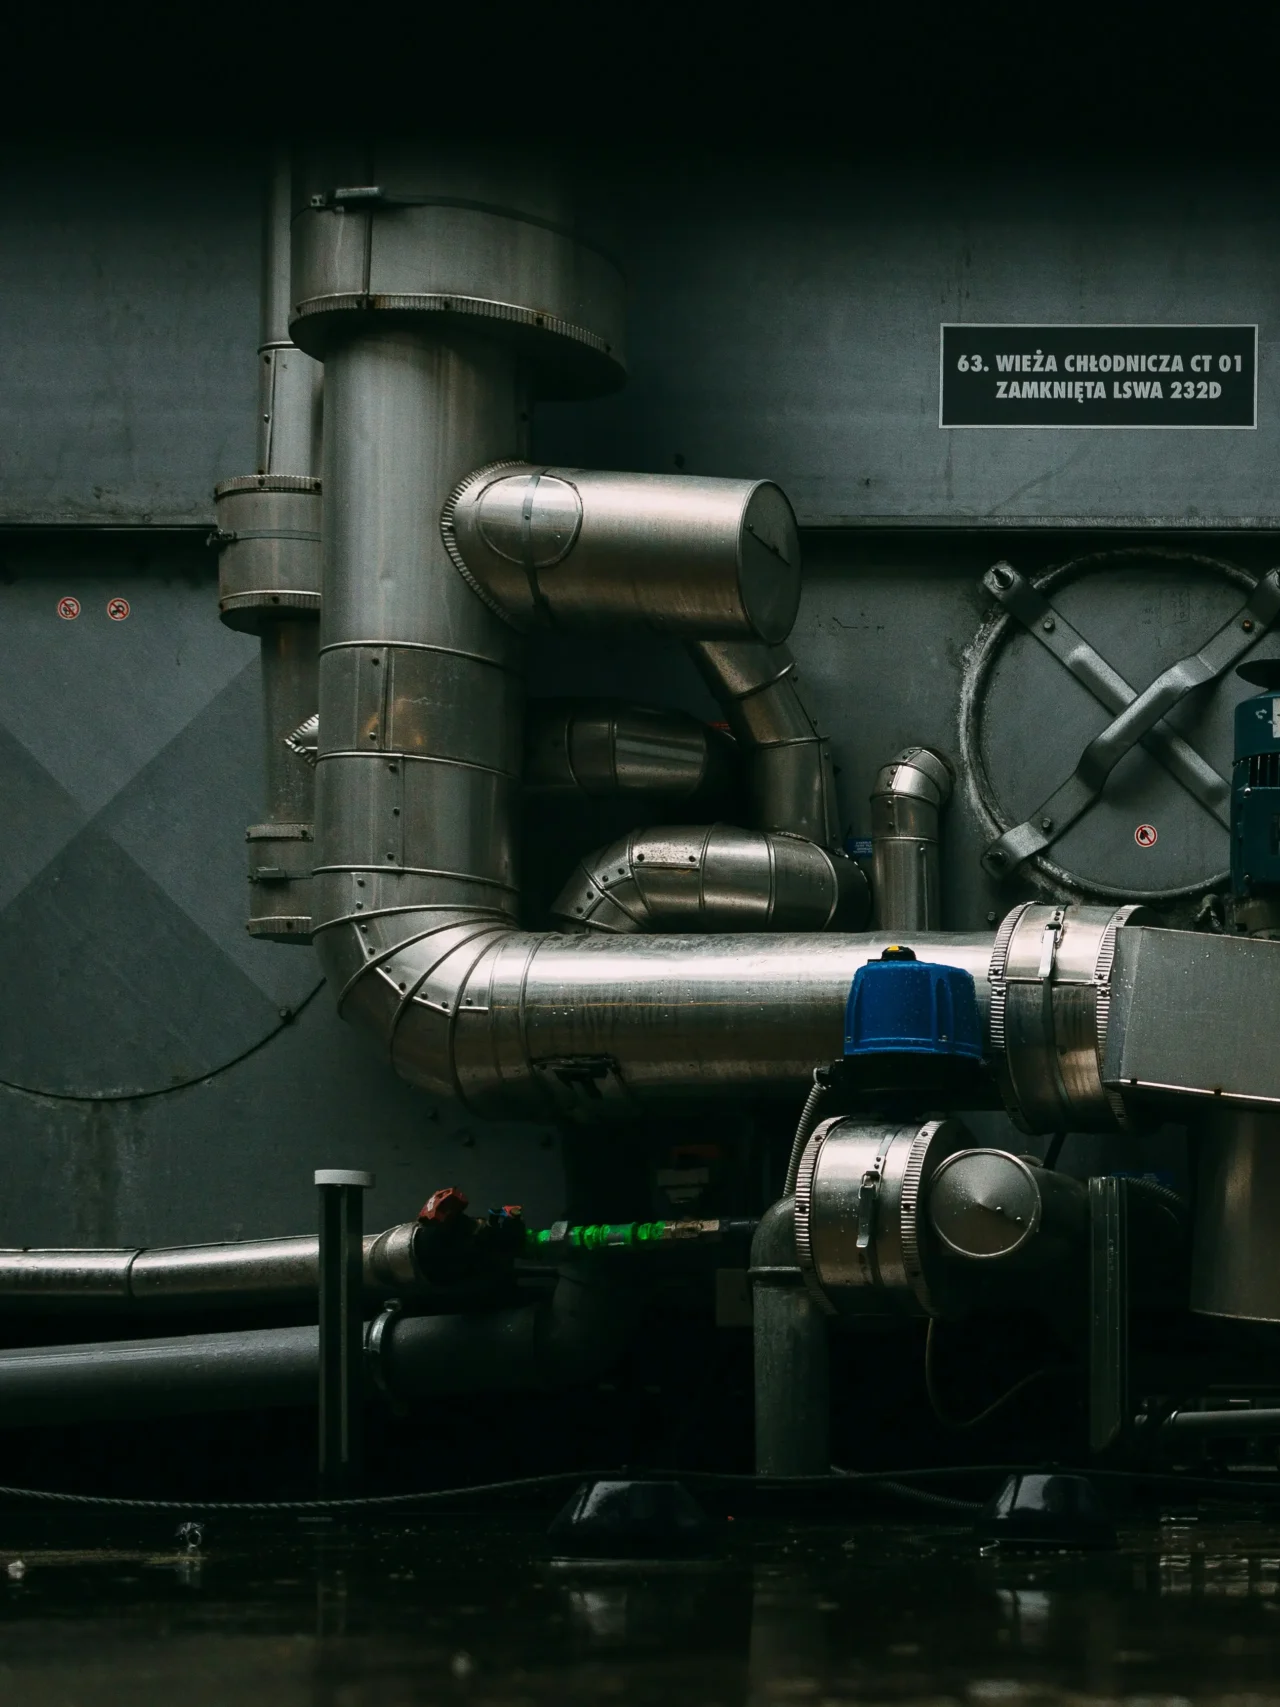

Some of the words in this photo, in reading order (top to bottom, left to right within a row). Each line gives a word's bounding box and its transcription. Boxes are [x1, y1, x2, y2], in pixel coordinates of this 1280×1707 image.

[957, 354, 990, 373] 63.
[995, 348, 1058, 373] WIEŻA
[1064, 354, 1185, 373] CHŁODNICZA
[1190, 354, 1213, 373] CT
[1218, 354, 1242, 373] 01
[995, 380, 1107, 404] ZAMKNIĘTA
[1113, 380, 1164, 399] LSWA
[1169, 380, 1222, 399] 232D
